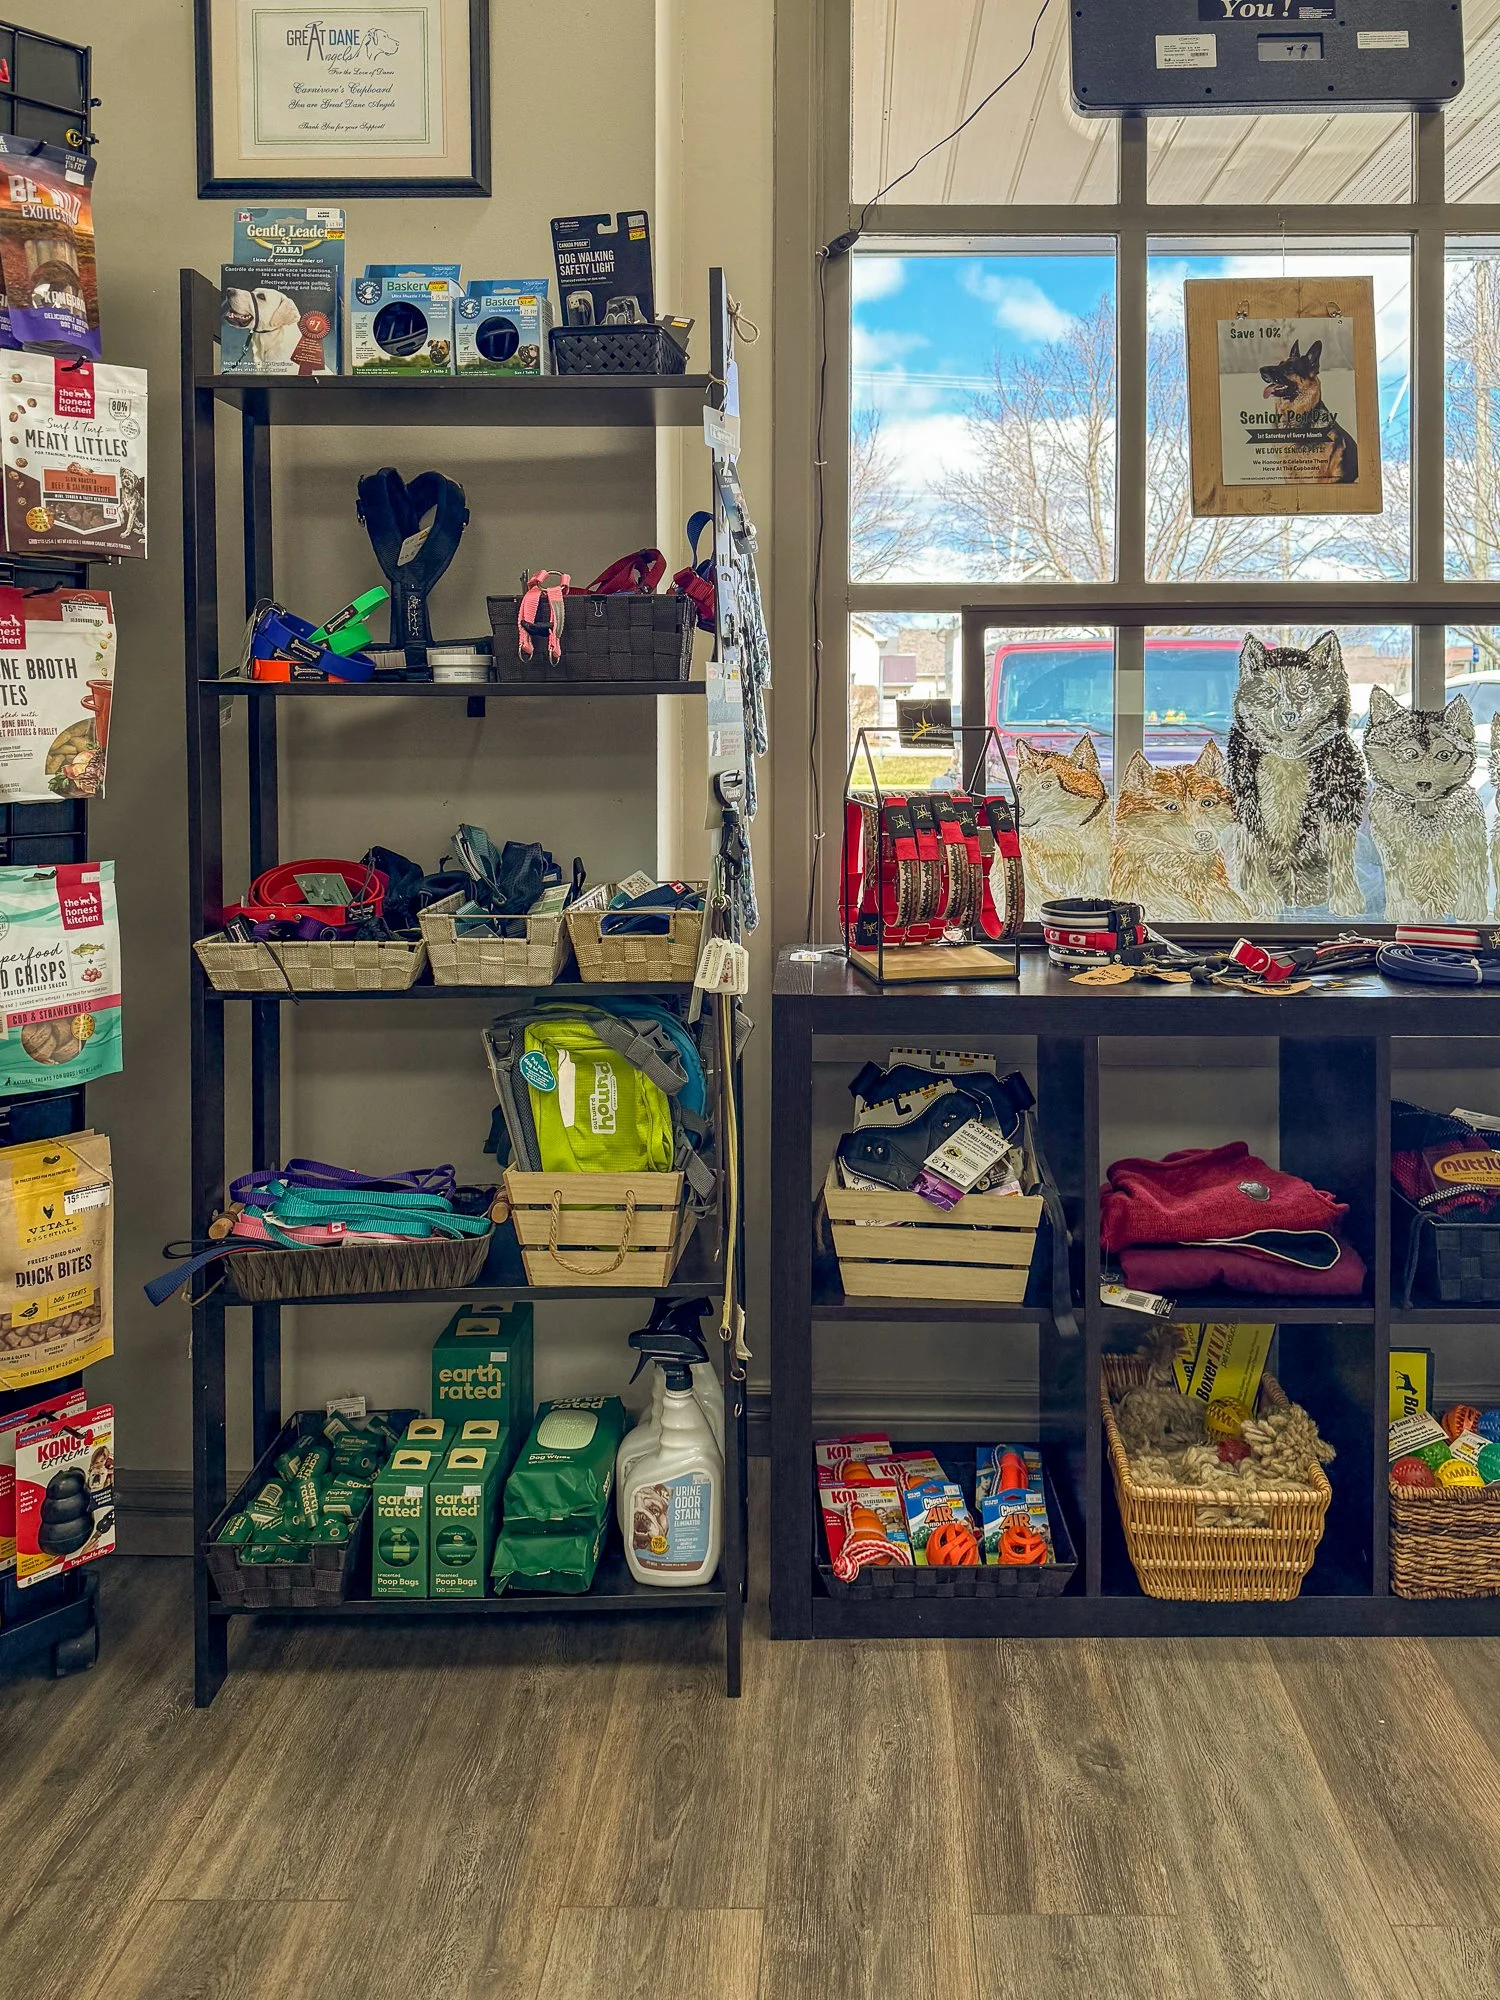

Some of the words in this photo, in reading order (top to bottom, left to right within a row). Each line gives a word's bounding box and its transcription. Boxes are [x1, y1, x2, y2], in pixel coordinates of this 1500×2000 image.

[1220, 0, 1274, 19] You
[1281, 0, 1292, 17] !
[329, 30, 360, 45] DANE
[293, 82, 345, 94] Carnivore's
[348, 82, 393, 96] Cupboard
[8, 175, 42, 204] BE
[247, 224, 285, 238] Gentle
[289, 225, 329, 239] Leader
[275, 246, 301, 254] PABA
[558, 253, 576, 265] DOG
[577, 250, 614, 263] WALKING
[560, 263, 590, 277] SAFETY
[592, 261, 615, 274] LIGHT
[309, 319, 321, 331] #1
[1230, 328, 1255, 339] Save
[1258, 327, 1281, 339] 10%
[59, 388, 74, 397] the
[59, 396, 92, 408] honest
[59, 403, 92, 415] kitchen
[111, 400, 128, 412] 80%
[1240, 410, 1283, 425] Senior
[1287, 410, 1310, 424] Pet
[1312, 409, 1338, 425] Day
[47, 418, 70, 433] Surf
[73, 419, 79, 430] &
[82, 422, 104, 437] Turf
[25, 428, 69, 450] MEATY
[74, 436, 129, 458] LITTLES
[1265, 432, 1287, 441] Saturday
[1255, 447, 1266, 455] WE
[1284, 446, 1307, 455] SENIOR
[1288, 458, 1313, 466] Celebrate
[1294, 465, 1320, 473] Cupboard
[26, 658, 78, 680] BROTH
[63, 898, 79, 908] the
[65, 904, 98, 916] honest
[66, 912, 99, 925] kitchen
[15, 959, 67, 987] CRISPS
[49, 981, 68, 990] SNACKS
[12, 1014, 28, 1025] COD
[30, 1012, 36, 1021] &
[39, 1001, 92, 1019] STRAWBERRIES
[598, 1061, 614, 1130] hound
[974, 1126, 1005, 1150] SHERPA
[28, 1218, 74, 1235] VITAL
[27, 1250, 67, 1266] FREEZE-DRIED
[67, 1246, 82, 1255] RAW
[15, 1265, 54, 1288] DUCK
[57, 1253, 92, 1279] BITES
[53, 1295, 65, 1304] DOG
[67, 1288, 87, 1300] TREATS
[439, 1364, 501, 1382] earth
[439, 1382, 502, 1400] rated
[96, 1407, 112, 1416] POWER
[550, 1400, 604, 1410] rated
[91, 1412, 112, 1422] CHEWERS
[37, 1435, 82, 1463] KONG
[827, 1446, 852, 1460] KO
[41, 1446, 90, 1470] EXTREME
[879, 1463, 905, 1477] KO
[675, 1485, 702, 1496] URINE
[831, 1490, 858, 1504] KO
[299, 1484, 313, 1515] rated
[378, 1494, 421, 1506] earth
[435, 1494, 477, 1505] earth
[674, 1496, 701, 1509] ODOR
[378, 1505, 421, 1517] rated
[435, 1504, 478, 1516] rated
[674, 1508, 701, 1520] STAIN
[925, 1506, 954, 1523] AIR
[1000, 1504, 1028, 1517] Chuckit!
[999, 1514, 1031, 1530] AIR
[377, 1578, 398, 1586] Poop
[399, 1578, 419, 1586] Bags
[436, 1578, 455, 1586] Poop
[456, 1578, 478, 1586] Bags
